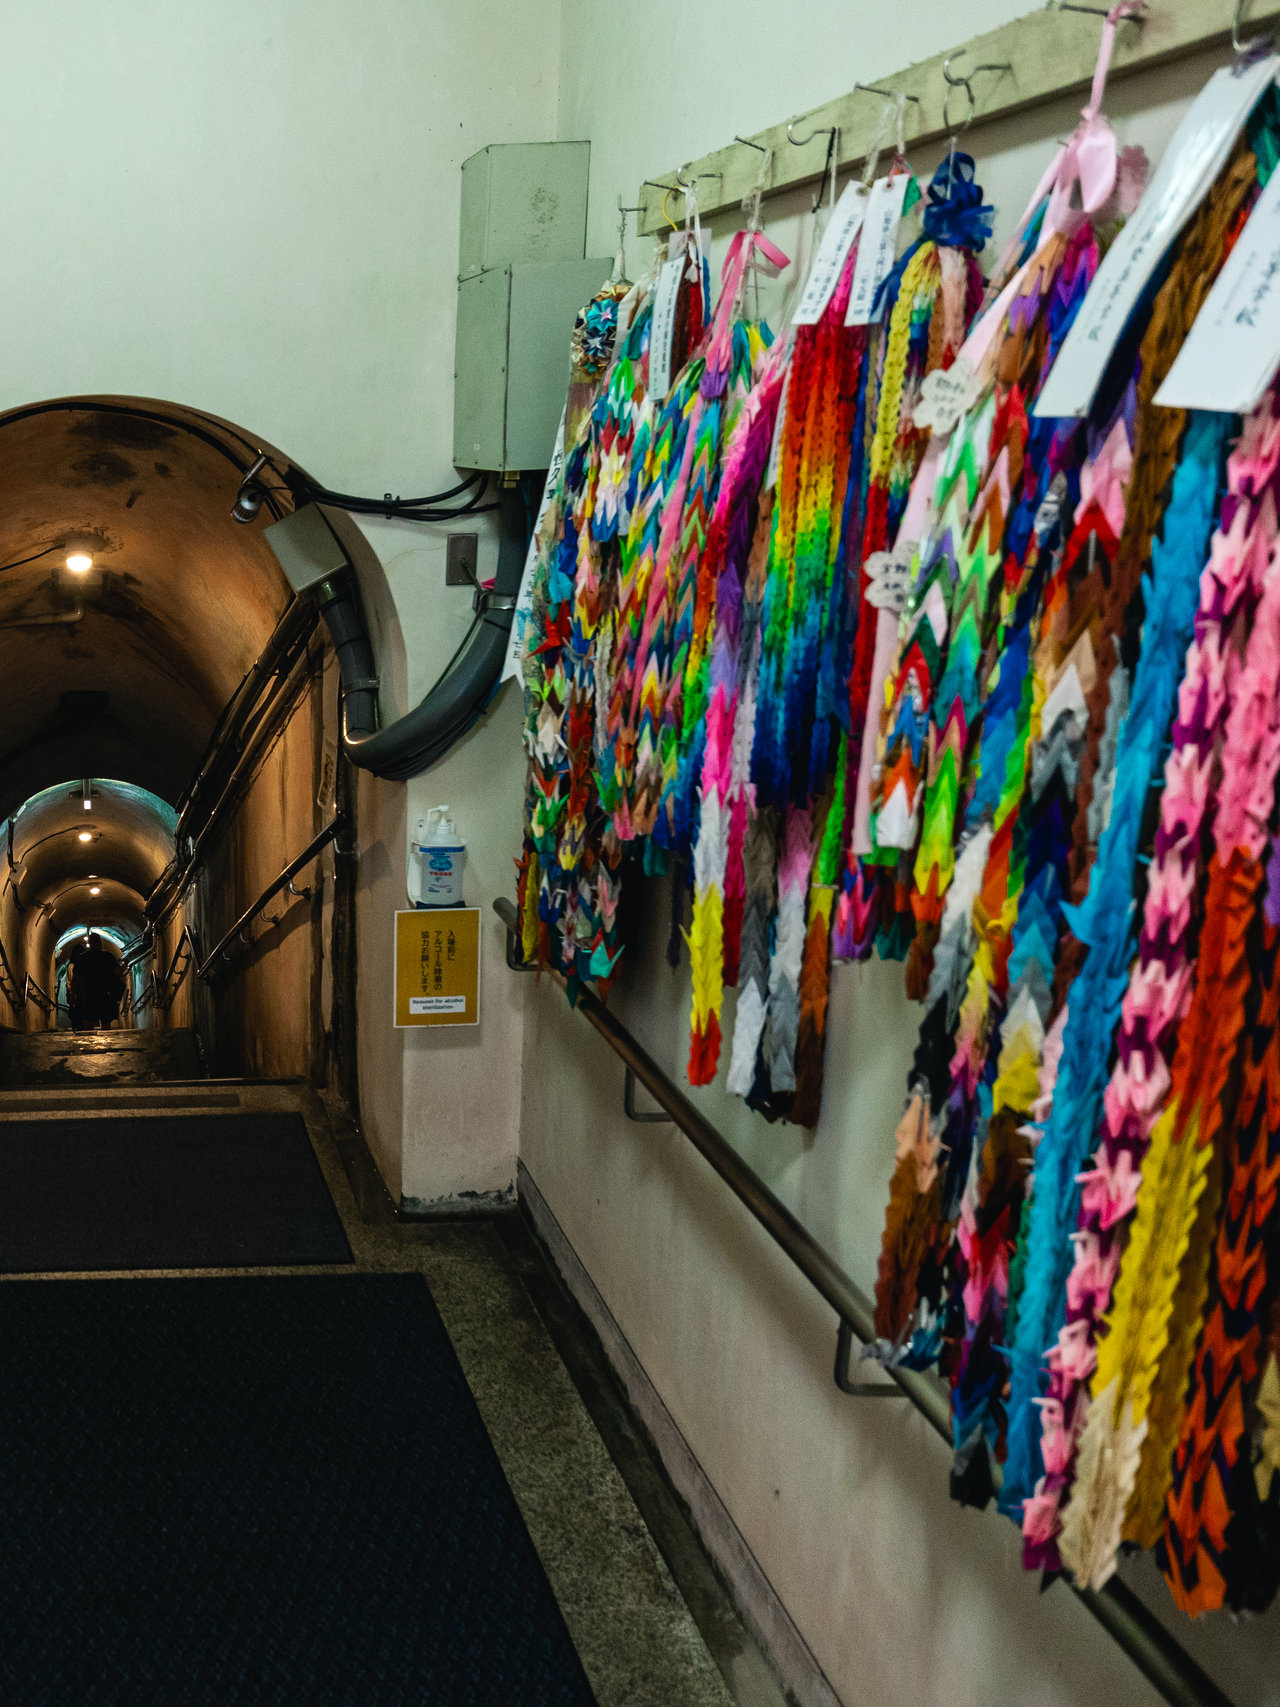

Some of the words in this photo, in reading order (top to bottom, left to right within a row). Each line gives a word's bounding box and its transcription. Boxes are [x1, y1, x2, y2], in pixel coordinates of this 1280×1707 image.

[433, 931, 443, 991] アルコール除菌の
[447, 930, 456, 961] 入場前に
